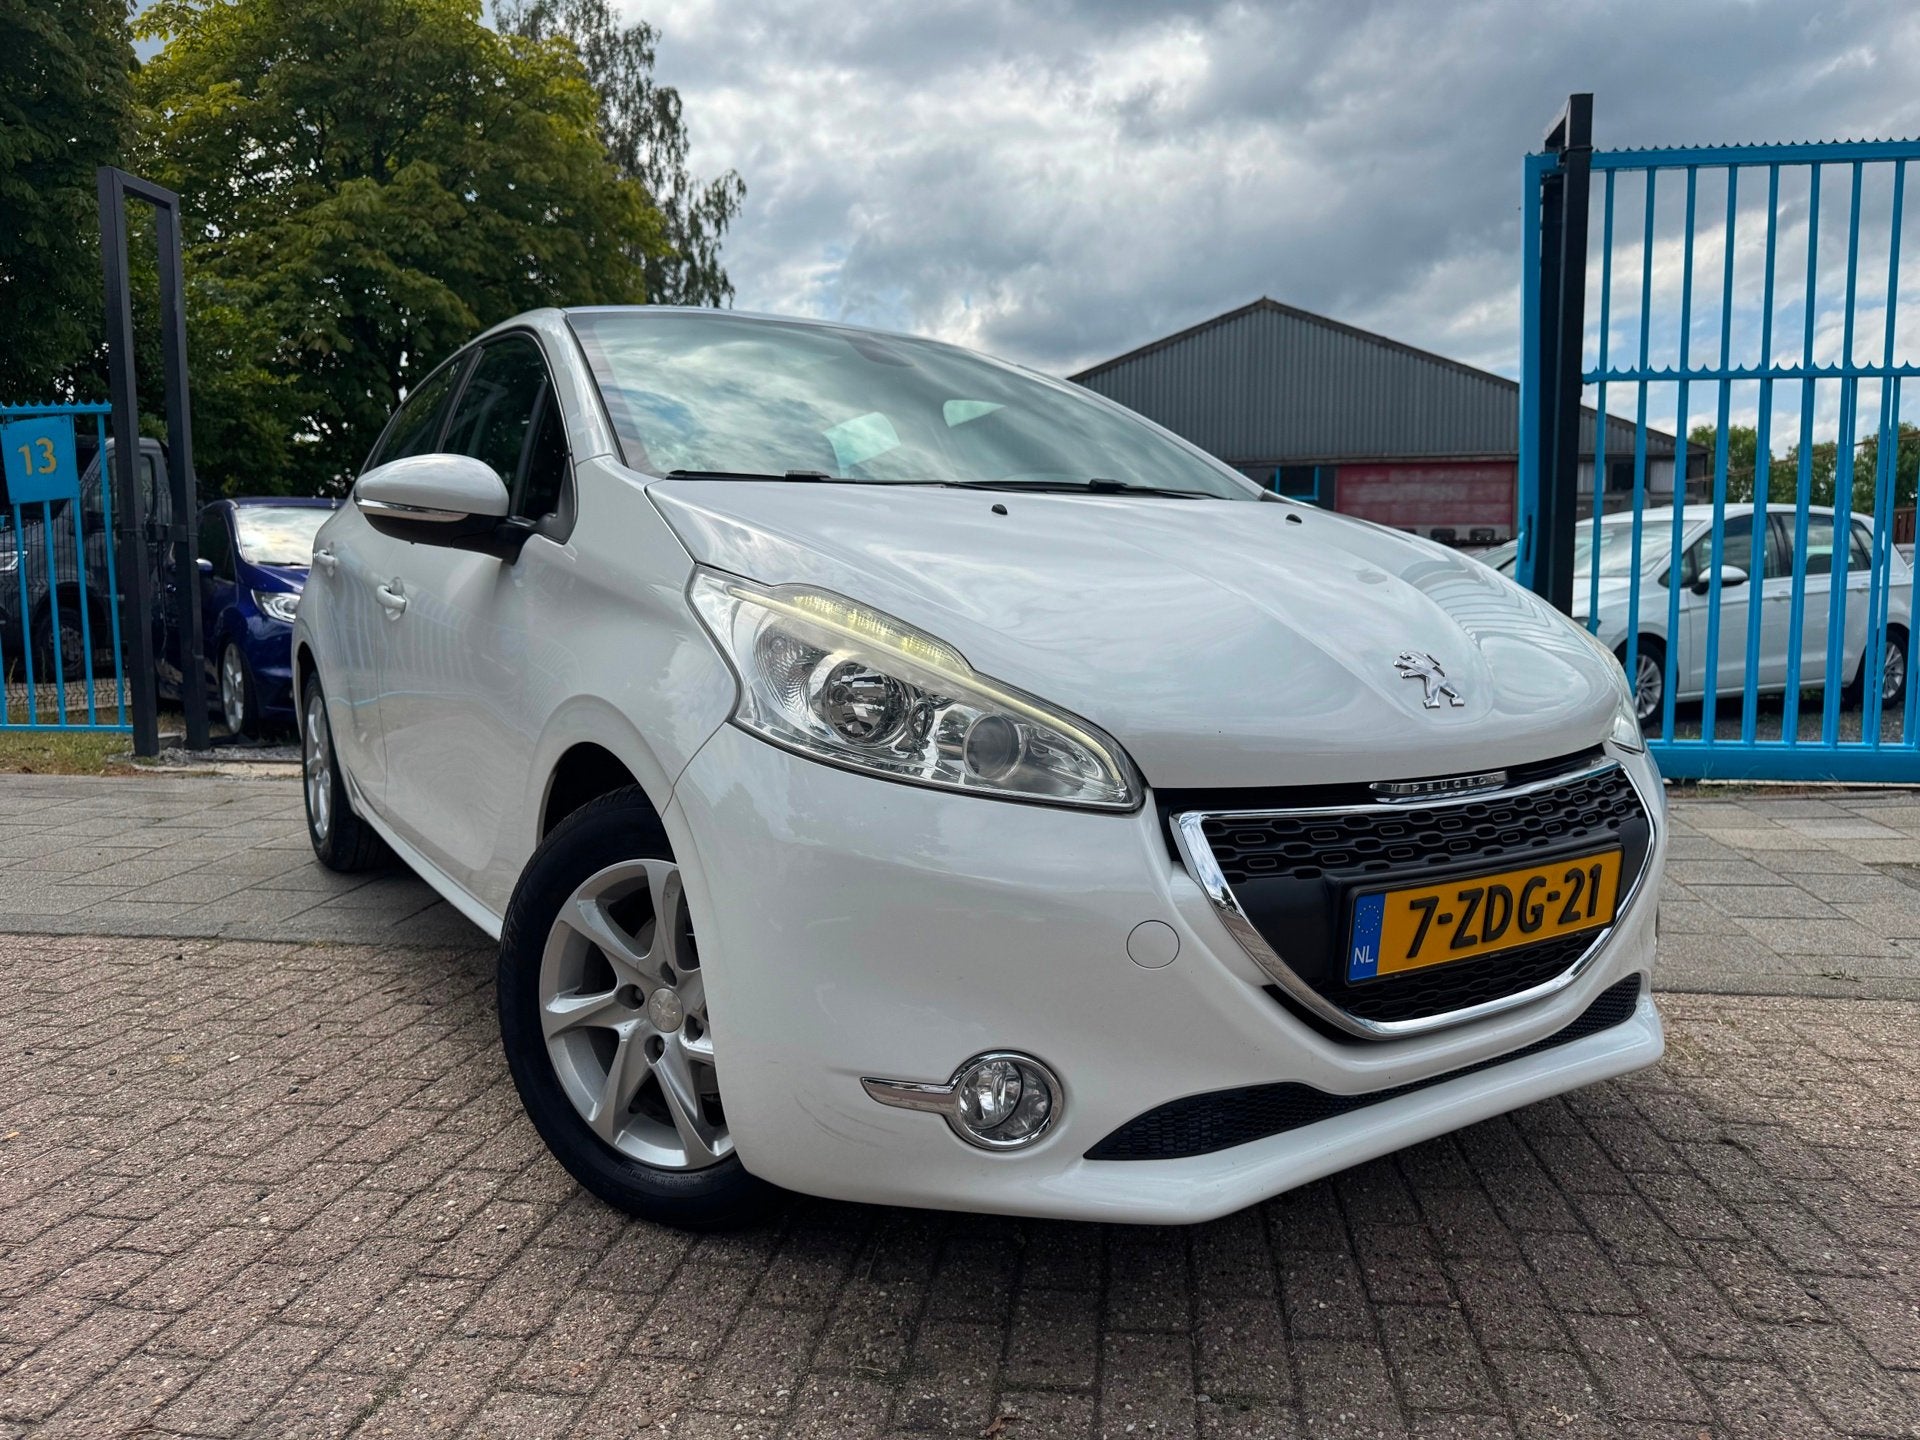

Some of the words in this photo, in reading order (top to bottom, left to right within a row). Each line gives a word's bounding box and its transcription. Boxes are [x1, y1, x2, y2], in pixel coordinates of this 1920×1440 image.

[18, 437, 57, 476] 13
[1406, 863, 1603, 959] 7-ZDG-21
[1353, 945, 1374, 966] NL
